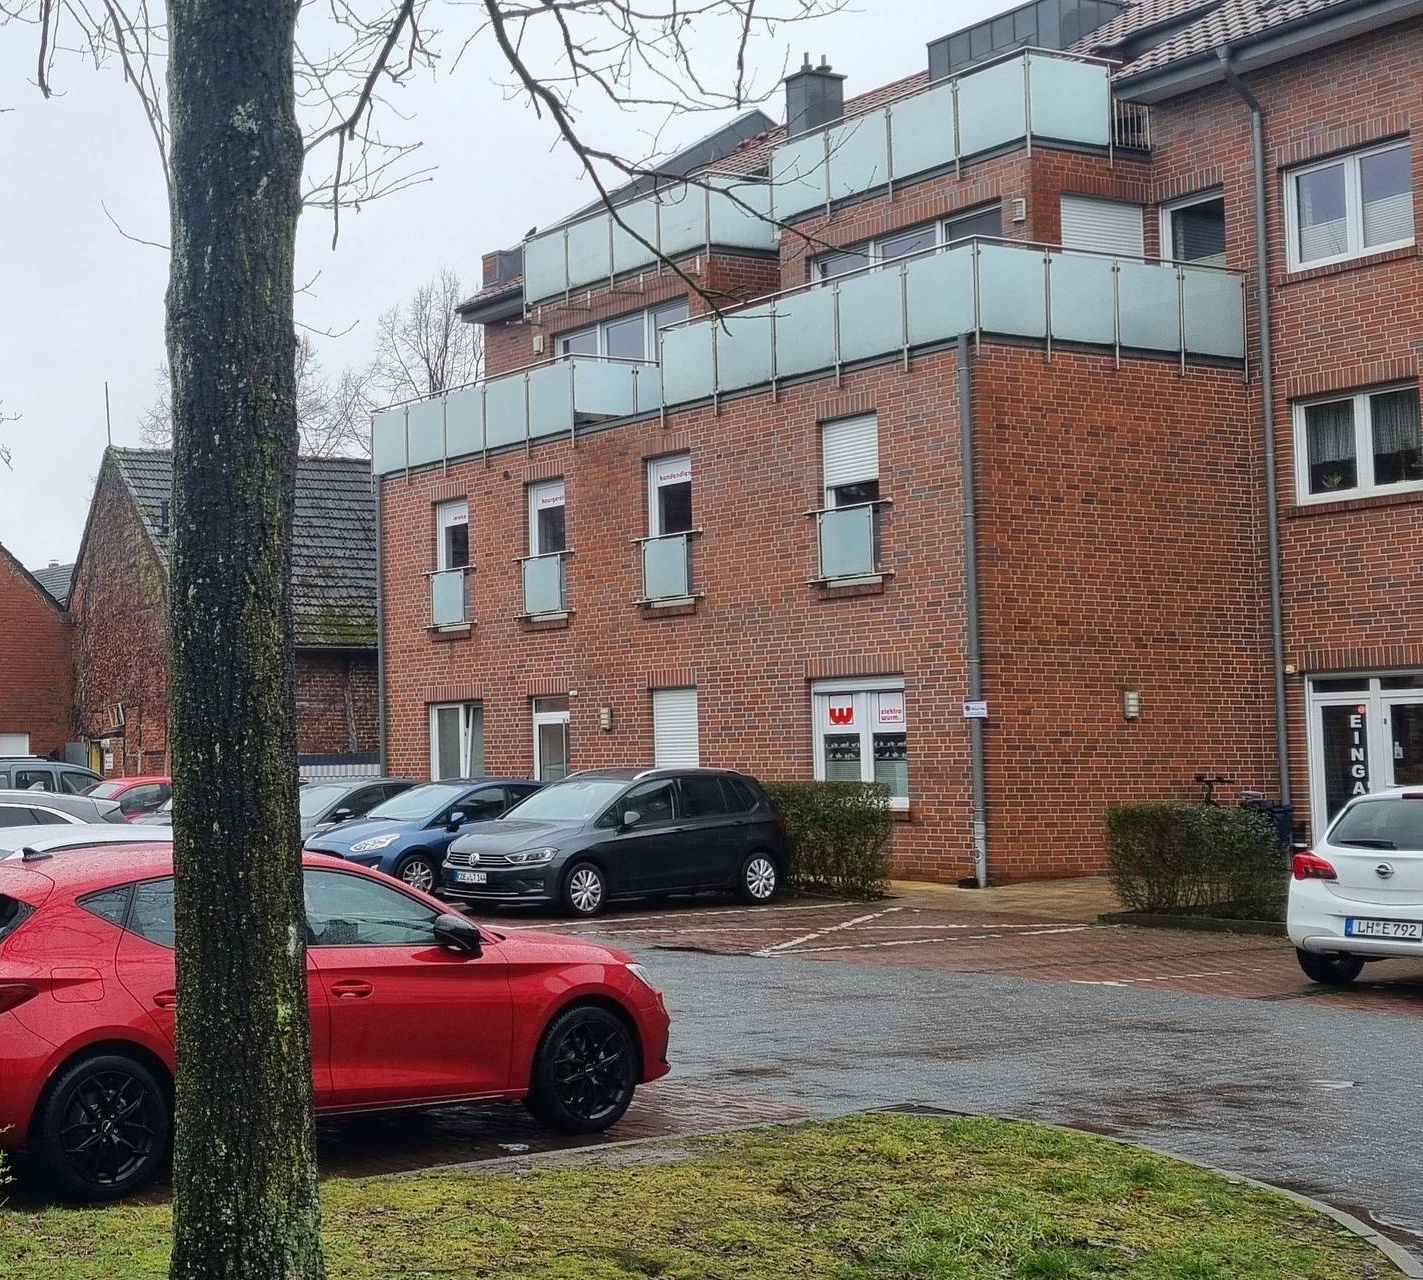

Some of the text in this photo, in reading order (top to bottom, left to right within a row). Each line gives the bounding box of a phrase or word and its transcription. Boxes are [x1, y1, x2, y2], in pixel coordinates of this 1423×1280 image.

[1350, 714, 1366, 794] EINGA
[1357, 921, 1417, 937] LH E 792
